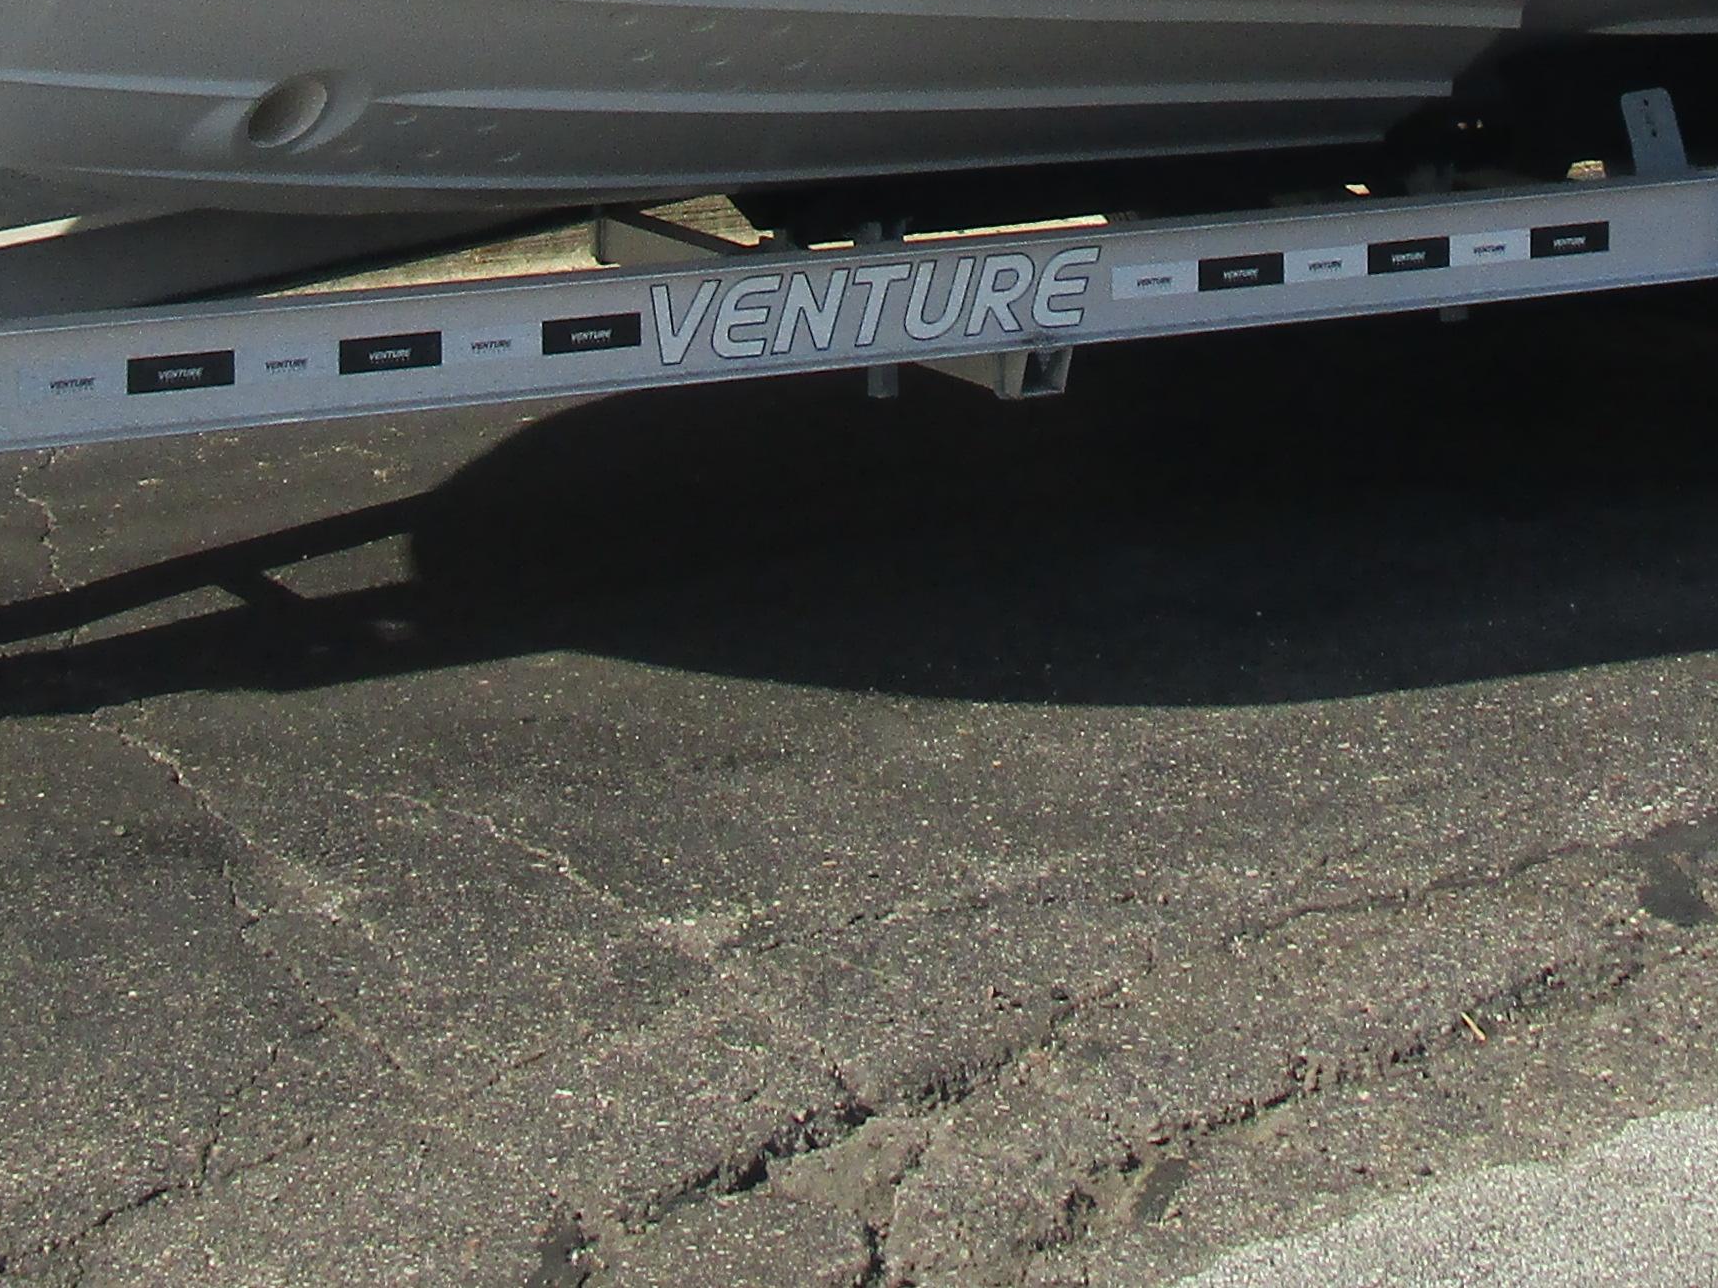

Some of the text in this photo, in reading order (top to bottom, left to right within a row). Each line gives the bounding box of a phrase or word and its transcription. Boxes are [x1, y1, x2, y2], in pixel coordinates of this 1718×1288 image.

[649, 246, 1101, 366] VENTURE
[265, 357, 309, 372] VENTURE
[159, 367, 204, 381] VENTURE
[50, 377, 96, 391] VENTURE
